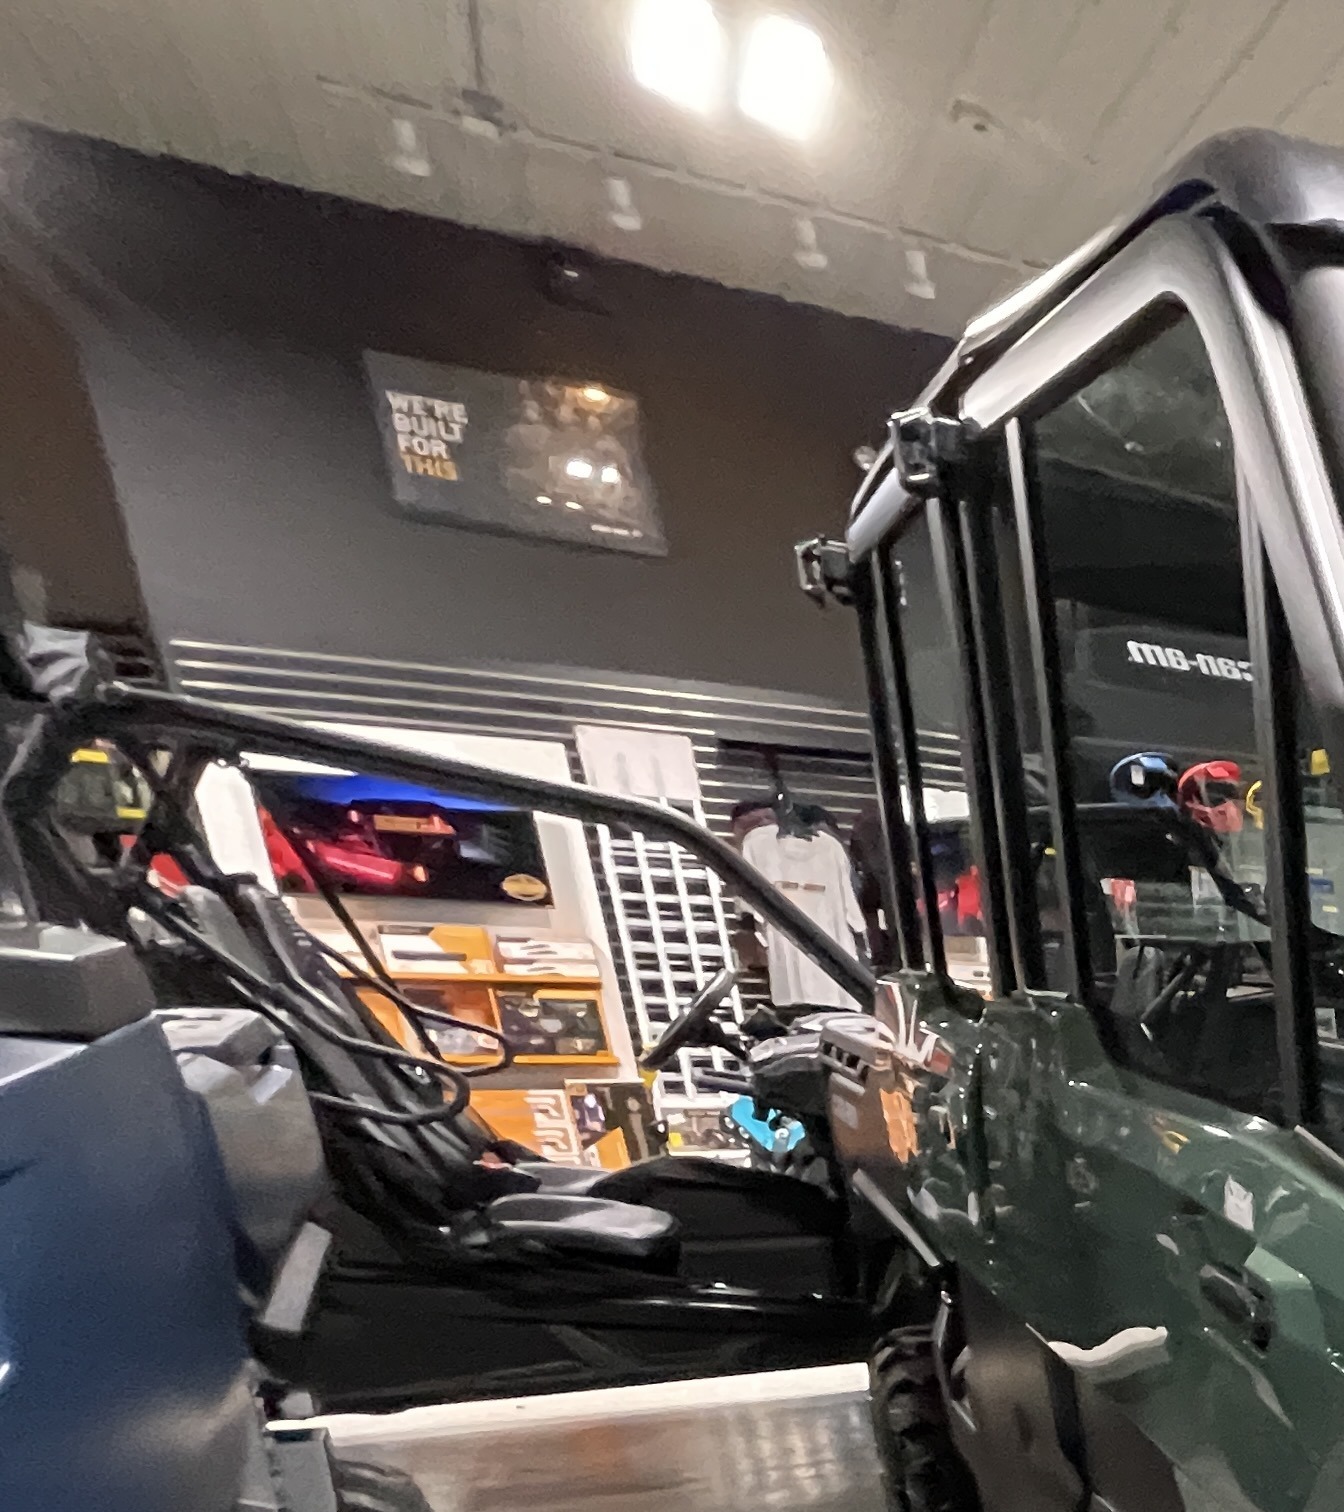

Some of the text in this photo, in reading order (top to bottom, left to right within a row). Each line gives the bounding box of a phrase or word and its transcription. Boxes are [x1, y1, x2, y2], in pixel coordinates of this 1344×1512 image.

[392, 412, 464, 444] BUILT
[397, 433, 450, 460] FOR
[401, 453, 458, 481] THIS
